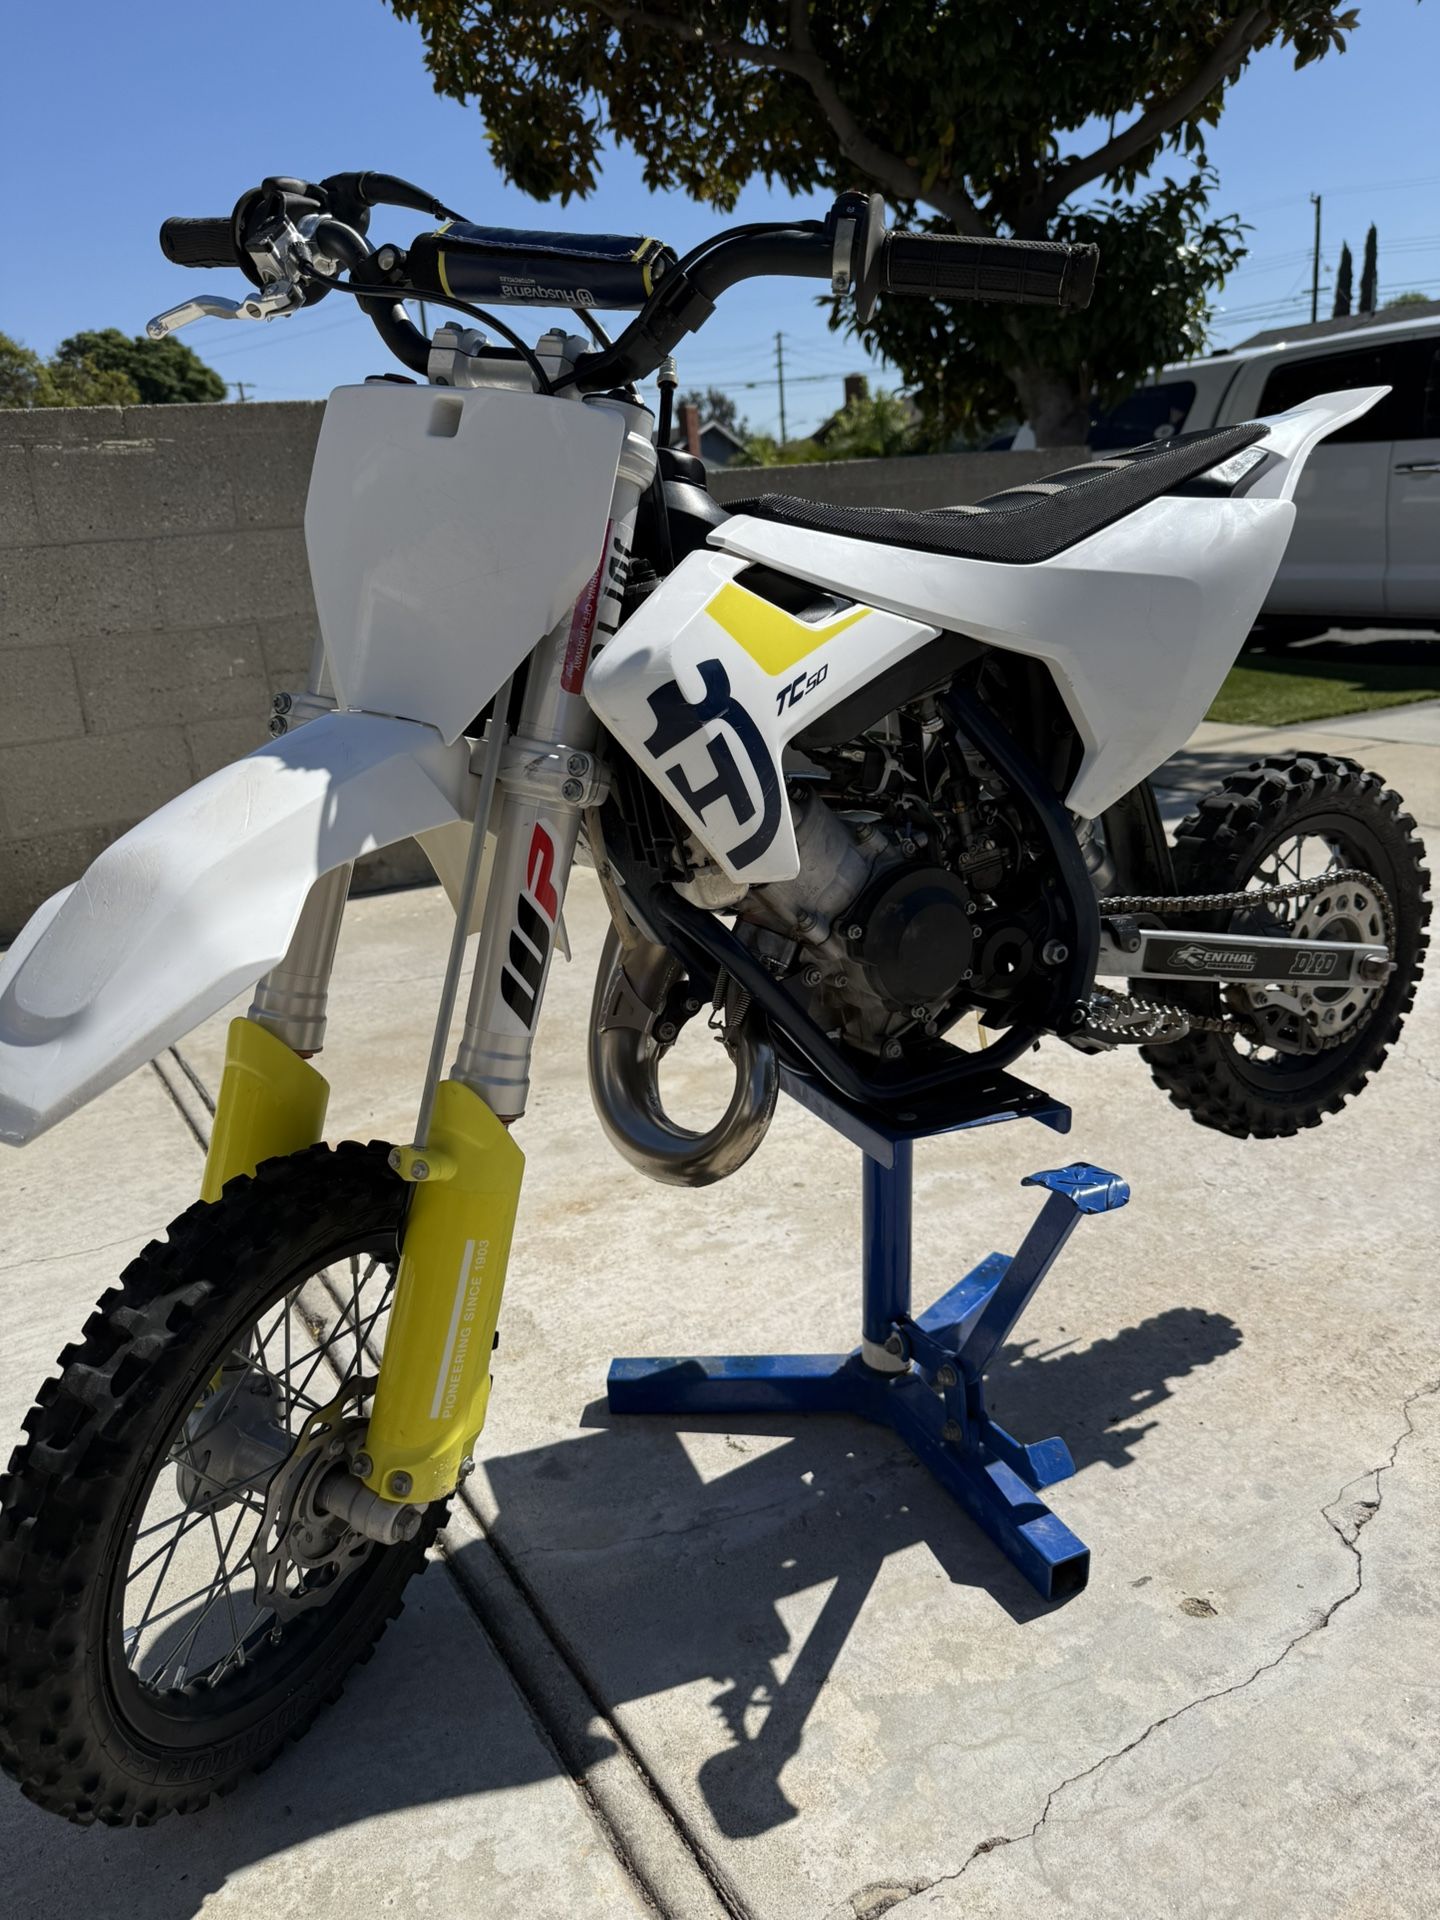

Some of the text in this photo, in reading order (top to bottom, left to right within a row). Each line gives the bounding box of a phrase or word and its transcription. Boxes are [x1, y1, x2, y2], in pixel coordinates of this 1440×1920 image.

[501, 285, 577, 303] Husqvarna
[501, 821, 558, 1031] WP
[442, 1239, 490, 1419] PIONEERING SINCE 1903
